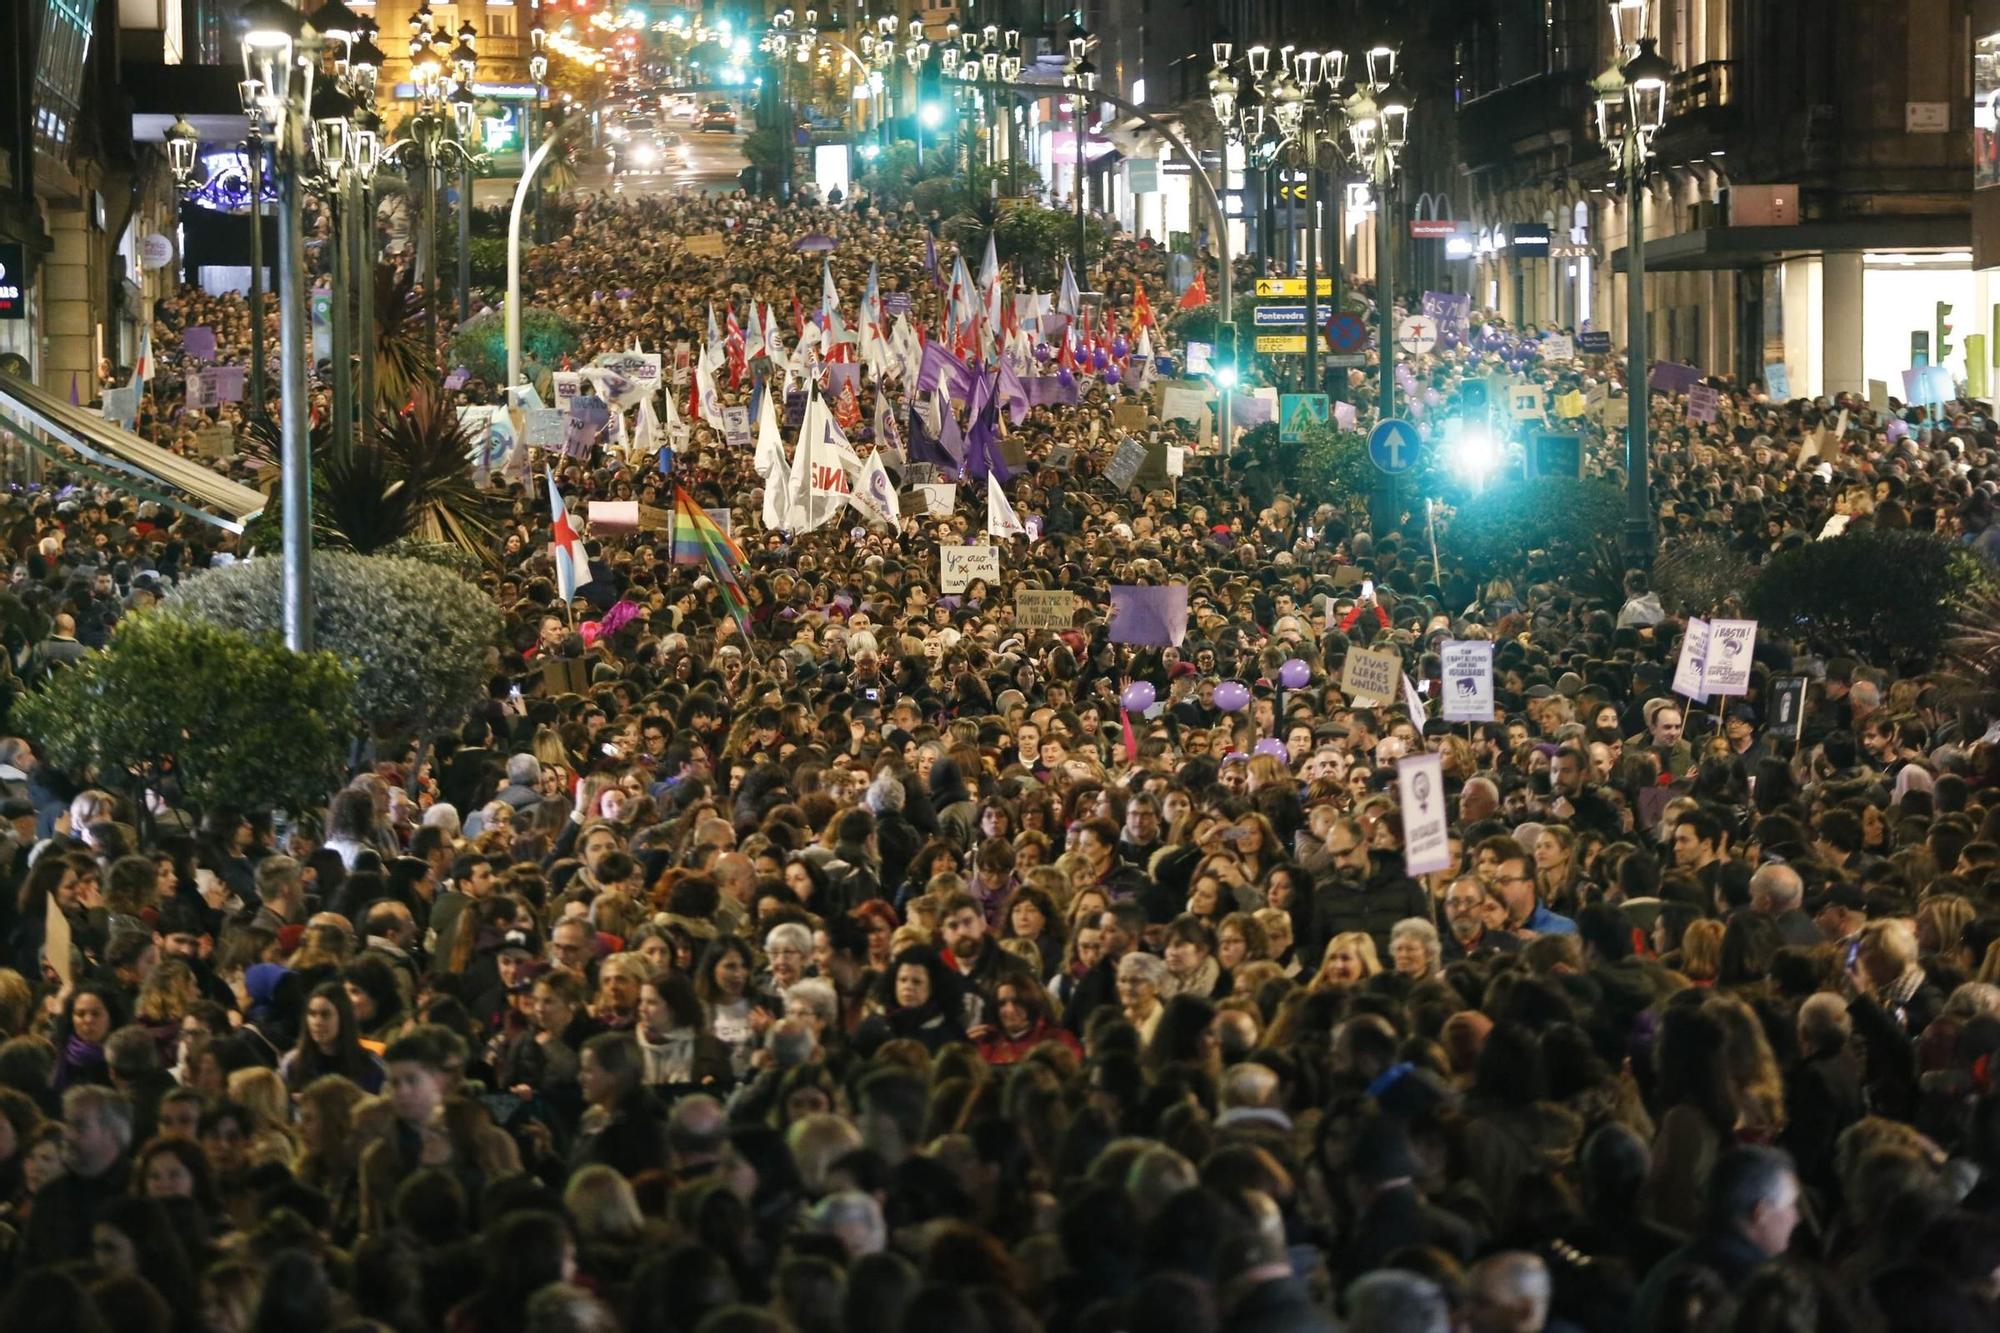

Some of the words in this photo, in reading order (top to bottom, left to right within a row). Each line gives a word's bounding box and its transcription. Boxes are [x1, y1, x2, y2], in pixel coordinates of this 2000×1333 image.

[1551, 247, 1598, 257] ZARA
[1257, 311, 1305, 320] Pontevedra
[1354, 653, 1389, 671] VIVAS
[1352, 665, 1389, 685] LIBRES
[1350, 678, 1391, 694] UNIDAS
